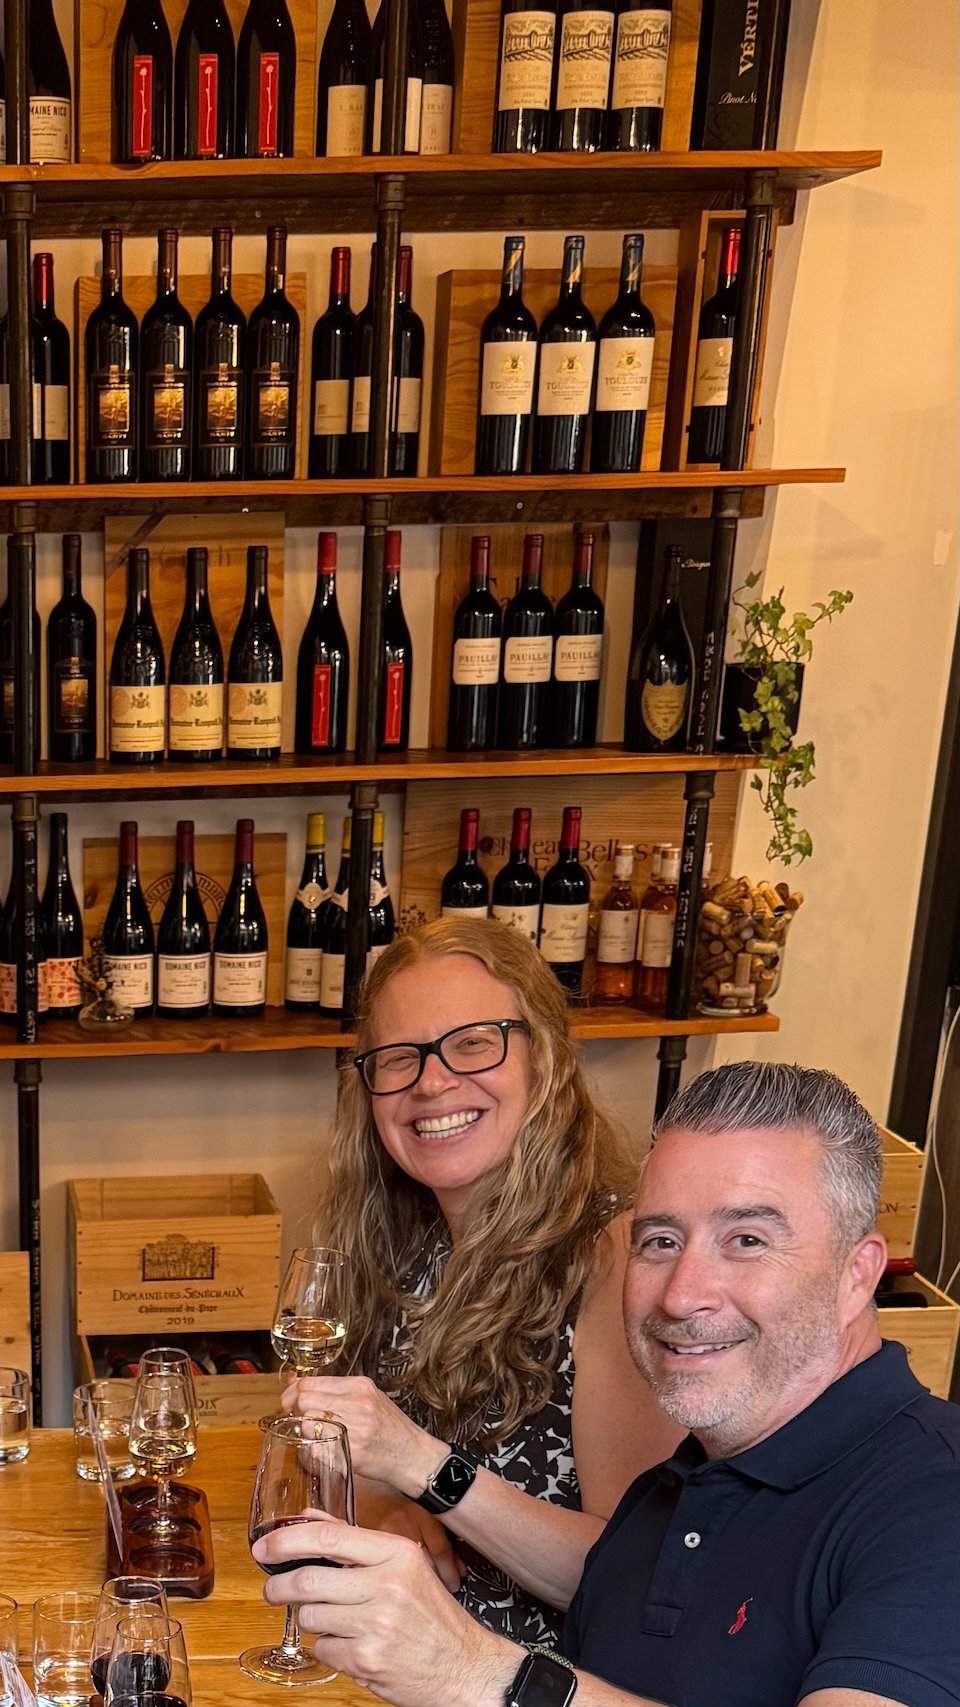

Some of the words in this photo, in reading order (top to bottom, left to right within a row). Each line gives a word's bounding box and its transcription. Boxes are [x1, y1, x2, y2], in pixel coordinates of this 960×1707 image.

[112, 1289, 162, 1301] DOMAINE
[164, 1291, 181, 1300] DES
[166, 1317, 195, 1325] 2019
